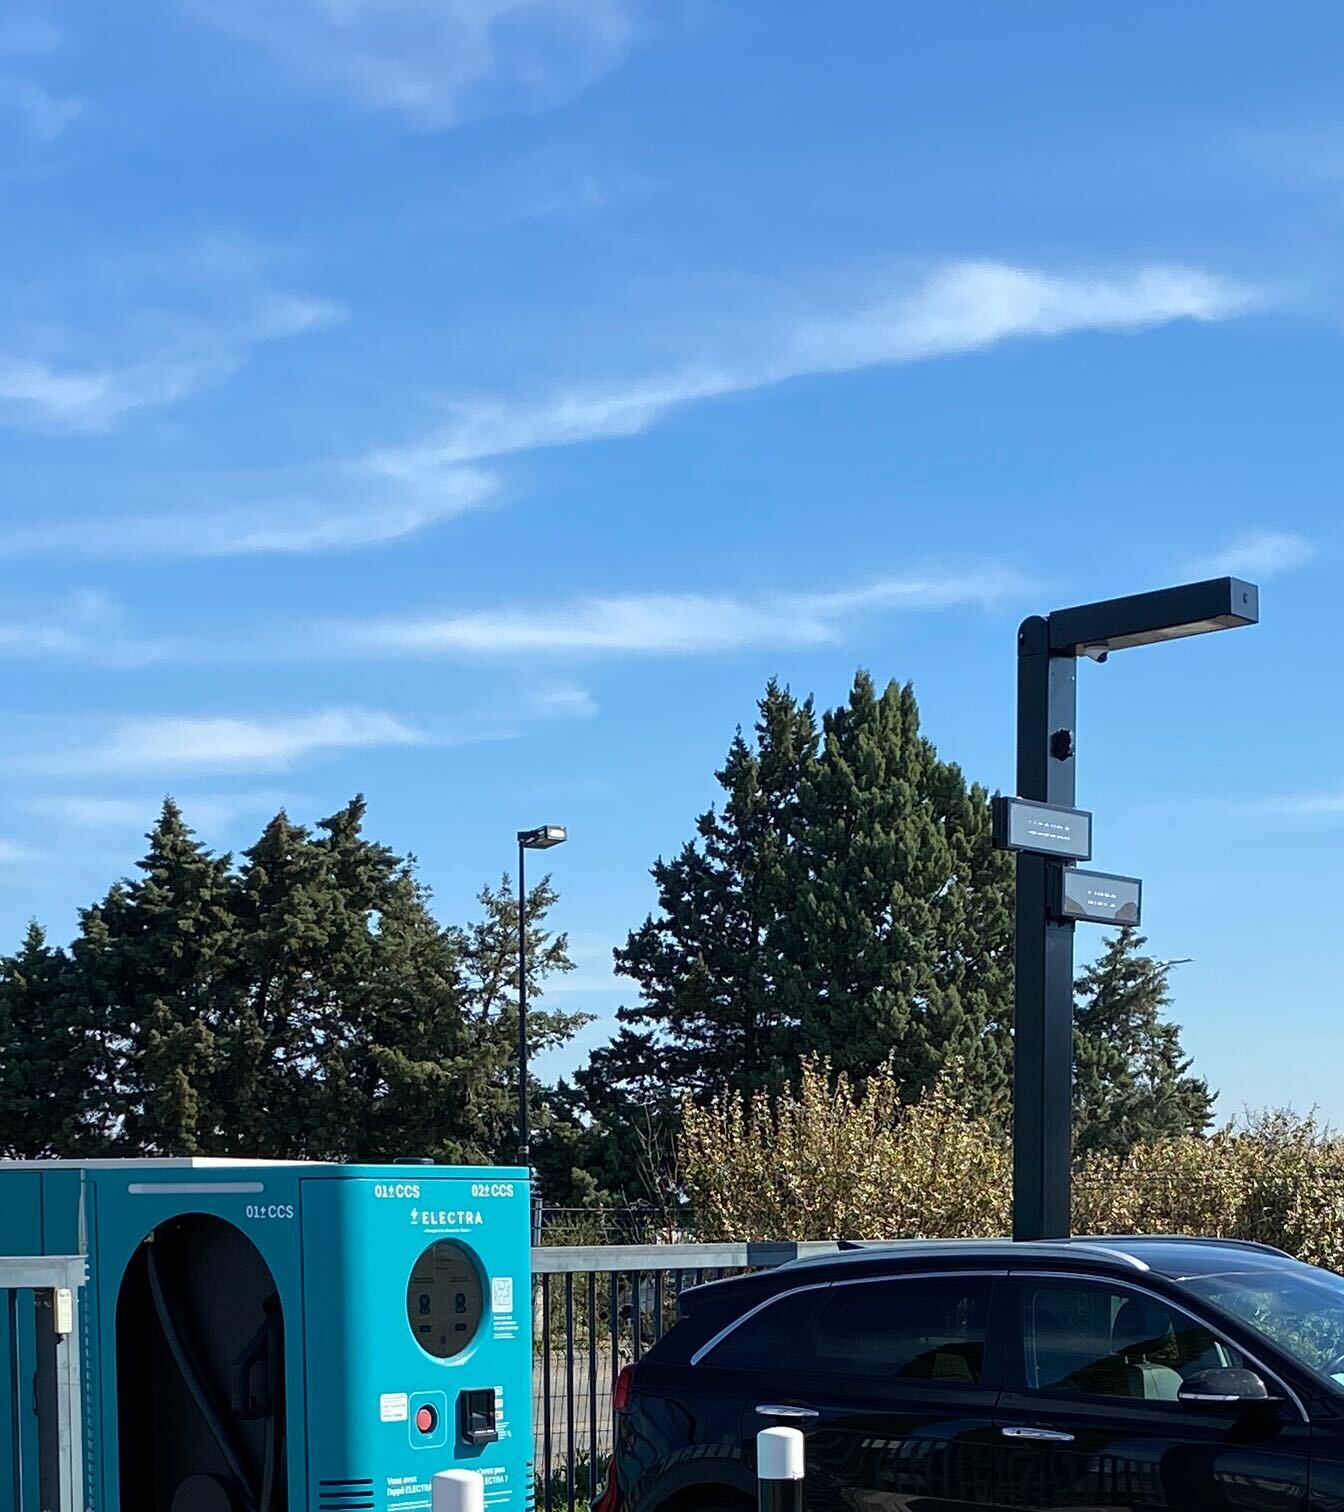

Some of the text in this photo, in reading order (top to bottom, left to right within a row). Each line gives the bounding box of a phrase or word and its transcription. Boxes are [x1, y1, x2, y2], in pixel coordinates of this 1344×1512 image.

[396, 1184, 420, 1198] CCS
[491, 1184, 514, 1197] CCS
[246, 1205, 294, 1218] 01 CCS
[422, 1211, 483, 1225] ELECTRA
